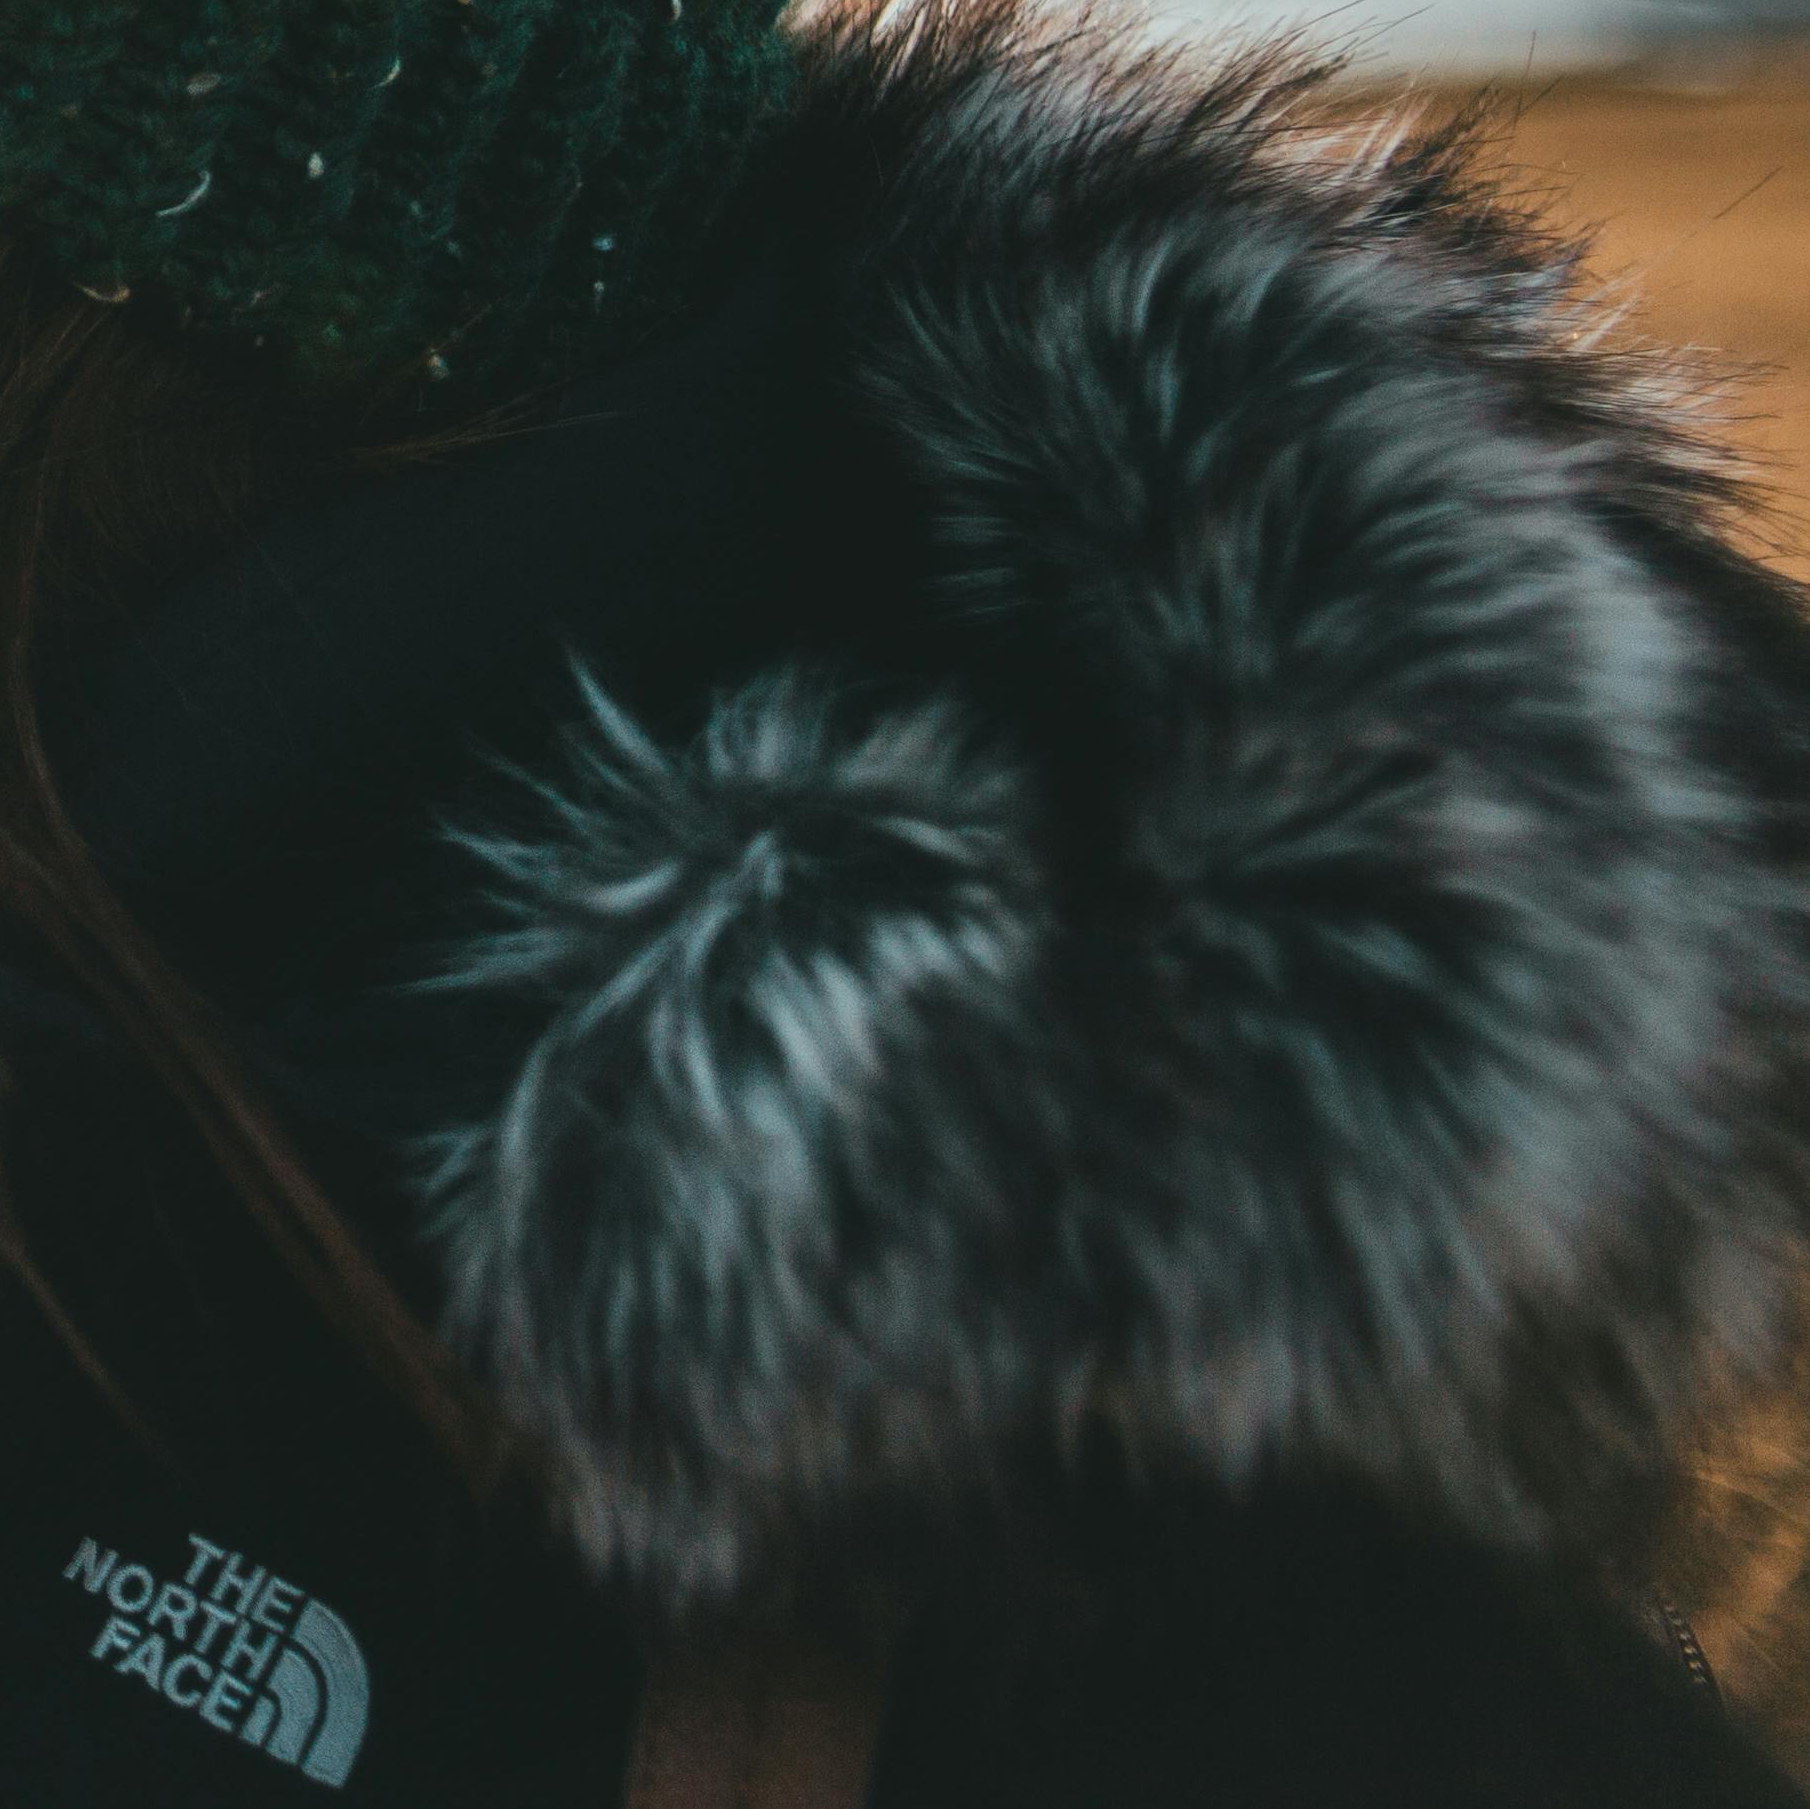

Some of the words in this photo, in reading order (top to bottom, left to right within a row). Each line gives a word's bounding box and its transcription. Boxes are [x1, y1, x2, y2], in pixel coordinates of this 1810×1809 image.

[62, 1537, 278, 1680] NORTH
[184, 1532, 305, 1633] THE
[89, 1617, 253, 1732] FACE
